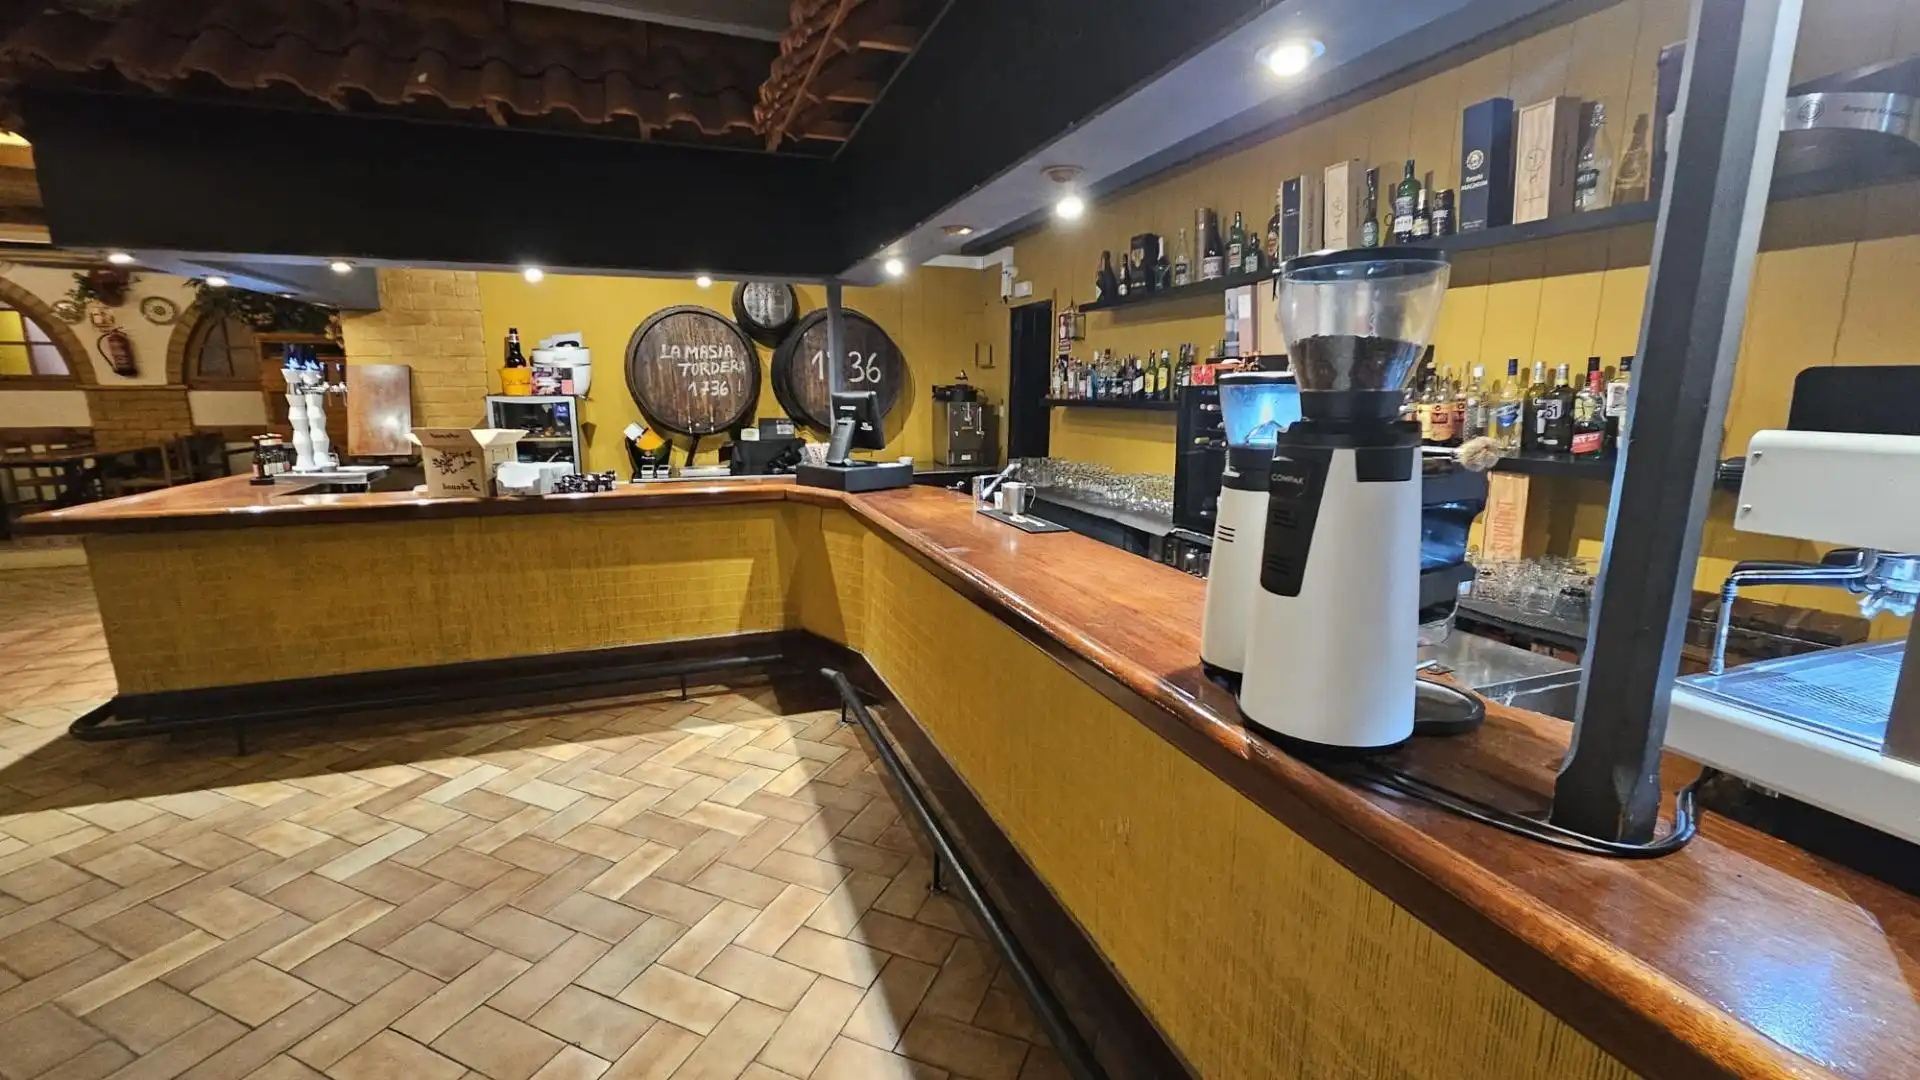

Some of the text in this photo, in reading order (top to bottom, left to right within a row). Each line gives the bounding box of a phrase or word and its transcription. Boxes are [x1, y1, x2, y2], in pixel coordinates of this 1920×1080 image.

[660, 343, 681, 359] LA
[677, 359, 746, 377] TORDERA
[811, 350, 882, 383] 136
[688, 380, 729, 397] 1736
